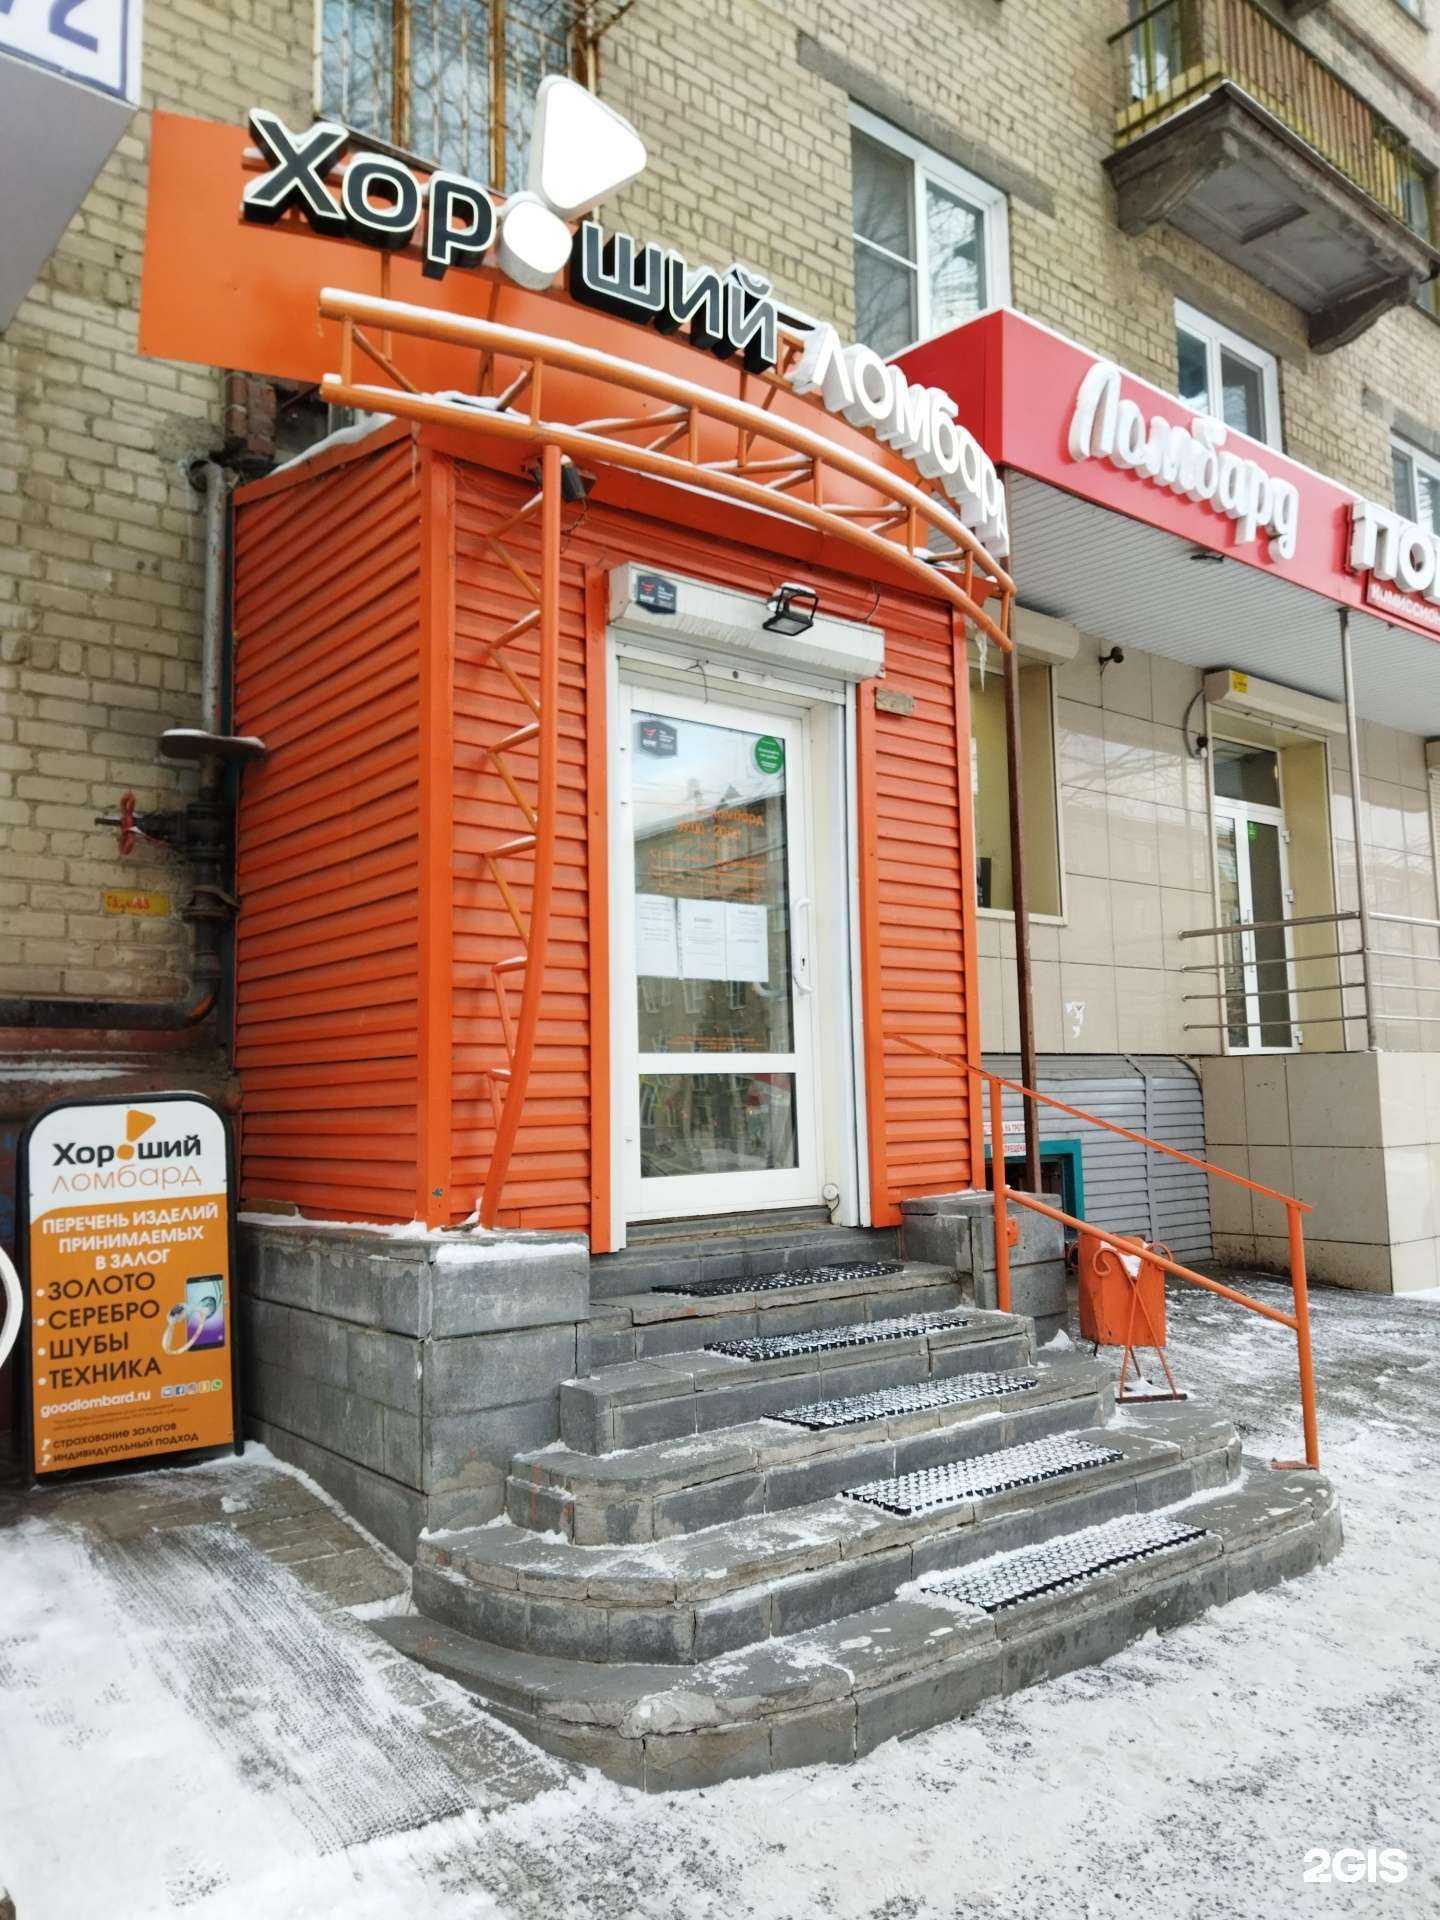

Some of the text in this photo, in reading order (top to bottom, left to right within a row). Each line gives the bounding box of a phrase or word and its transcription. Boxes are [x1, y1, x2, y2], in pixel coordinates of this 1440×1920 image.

[1069, 361, 1440, 605] Ломбард ПО
[42, 1201, 219, 1235] ПЕРЕЧЕНЬ ИЗДЕЛИЙ
[59, 1225, 205, 1254] ПРИНИМАЕМЫХ
[95, 1249, 171, 1270] В ЗАЛОГ
[48, 1272, 155, 1300] ЗОЛОТО
[49, 1300, 160, 1330] СЕРЕБРО
[49, 1332, 128, 1360] ШУБЫ
[49, 1357, 162, 1389] ТЕХНИКА
[40, 1390, 151, 1418] goodlombard.ru
[53, 1422, 177, 1450] страхование залогов
[53, 1432, 199, 1462] индивидуальный подход
